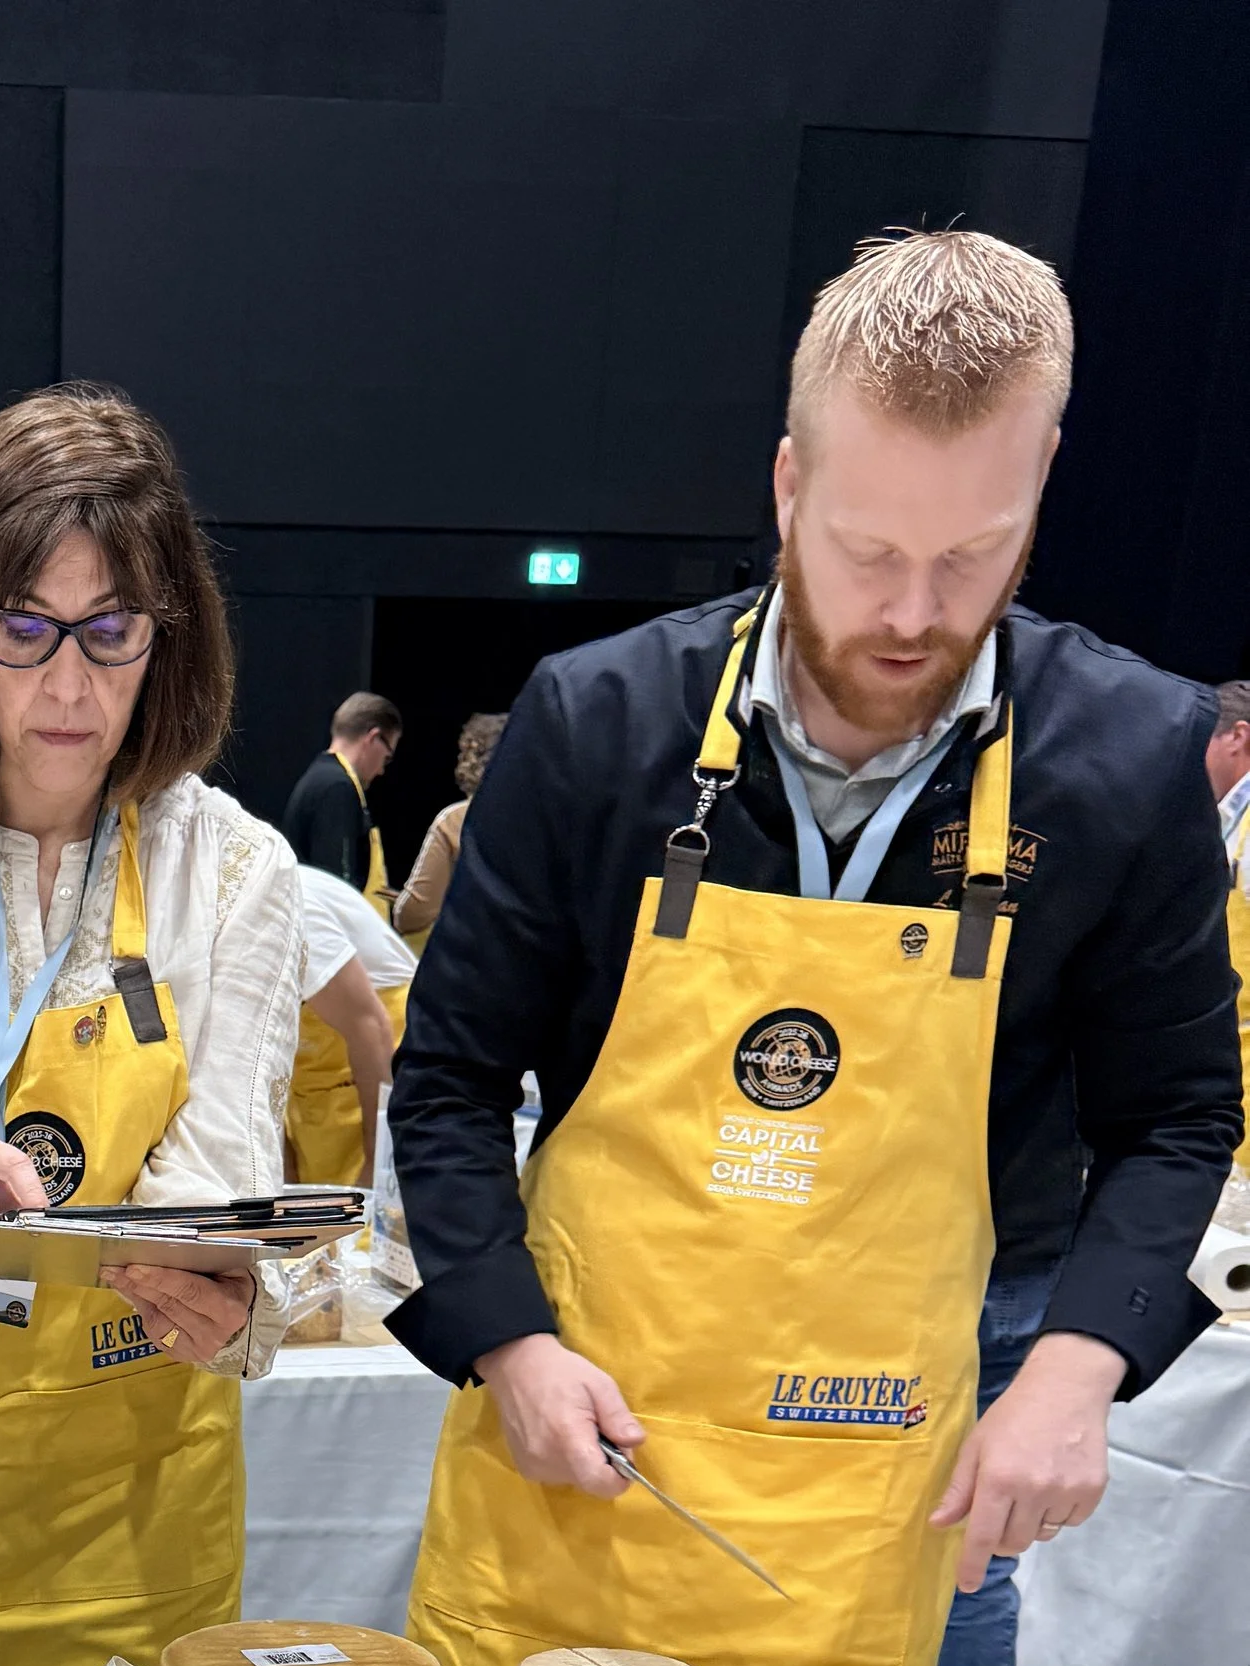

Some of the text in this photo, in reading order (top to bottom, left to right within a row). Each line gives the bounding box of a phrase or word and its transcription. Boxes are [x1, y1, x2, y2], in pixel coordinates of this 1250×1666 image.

[718, 1124, 823, 1154] CAPITAL
[711, 1160, 816, 1193] CHEESE
[91, 1321, 116, 1352] LE
[772, 1374, 806, 1403] LE
